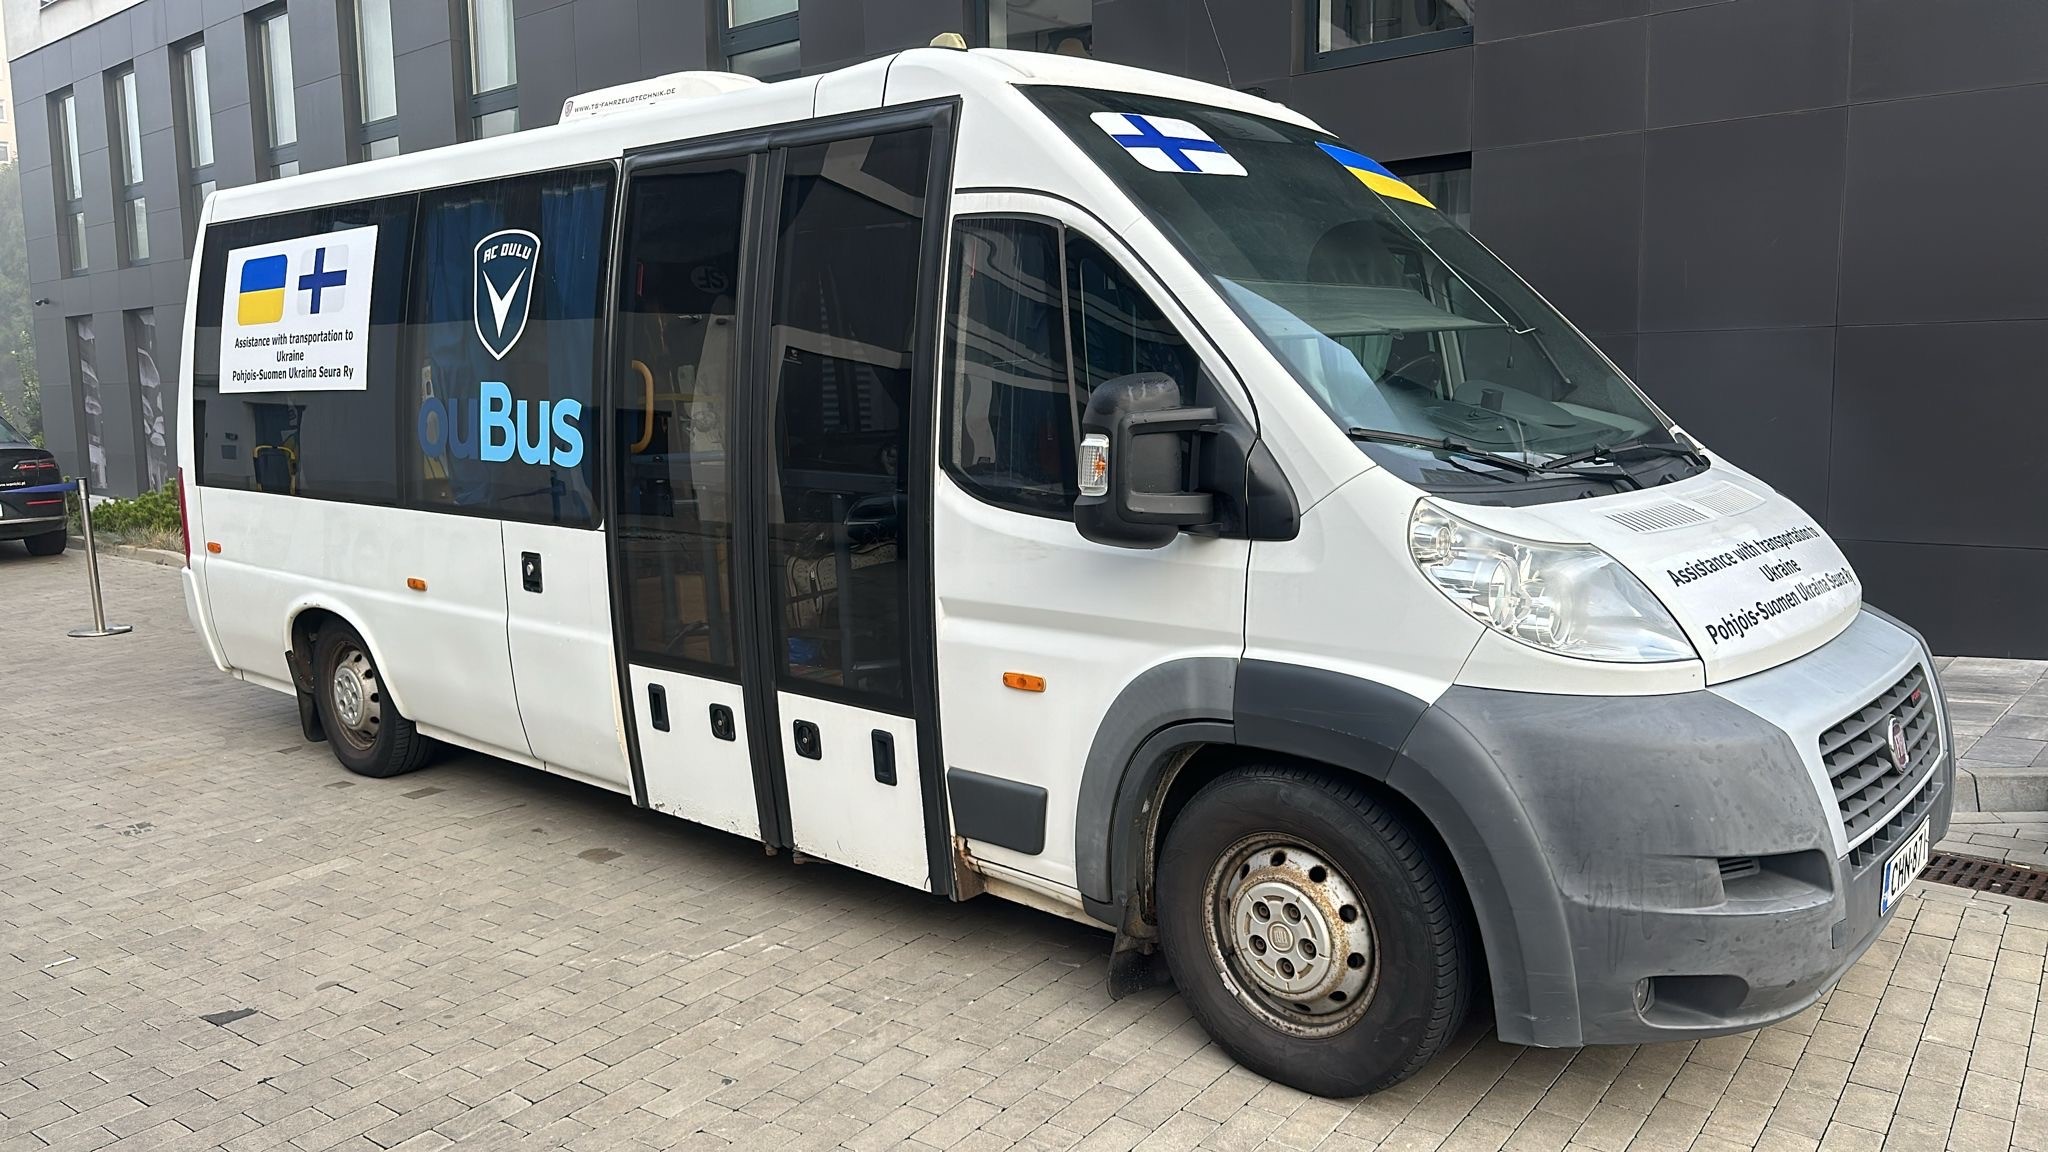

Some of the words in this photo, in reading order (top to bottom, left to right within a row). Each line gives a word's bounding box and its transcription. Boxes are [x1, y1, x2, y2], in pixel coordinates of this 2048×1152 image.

[483, 245, 498, 263] AC
[501, 243, 532, 260] OULU
[235, 336, 270, 348] Assistance
[272, 333, 287, 345] with
[289, 329, 343, 345] transportation
[345, 329, 354, 340] to
[276, 349, 304, 362] Ukraine
[232, 368, 286, 383] Pohjois-Suomen
[288, 366, 316, 379] Ukraina
[319, 365, 341, 378] Seura
[343, 365, 354, 380] Ry
[1666, 551, 1738, 587] Assistance
[1734, 540, 1760, 562] with
[1755, 526, 1811, 550] transportation
[1806, 525, 1820, 538] to
[1759, 557, 1801, 582] Ukraine
[1705, 591, 1801, 644] Pohjois-Suomen
[1797, 572, 1831, 600] Ukraina
[1825, 570, 1846, 590] Seura
